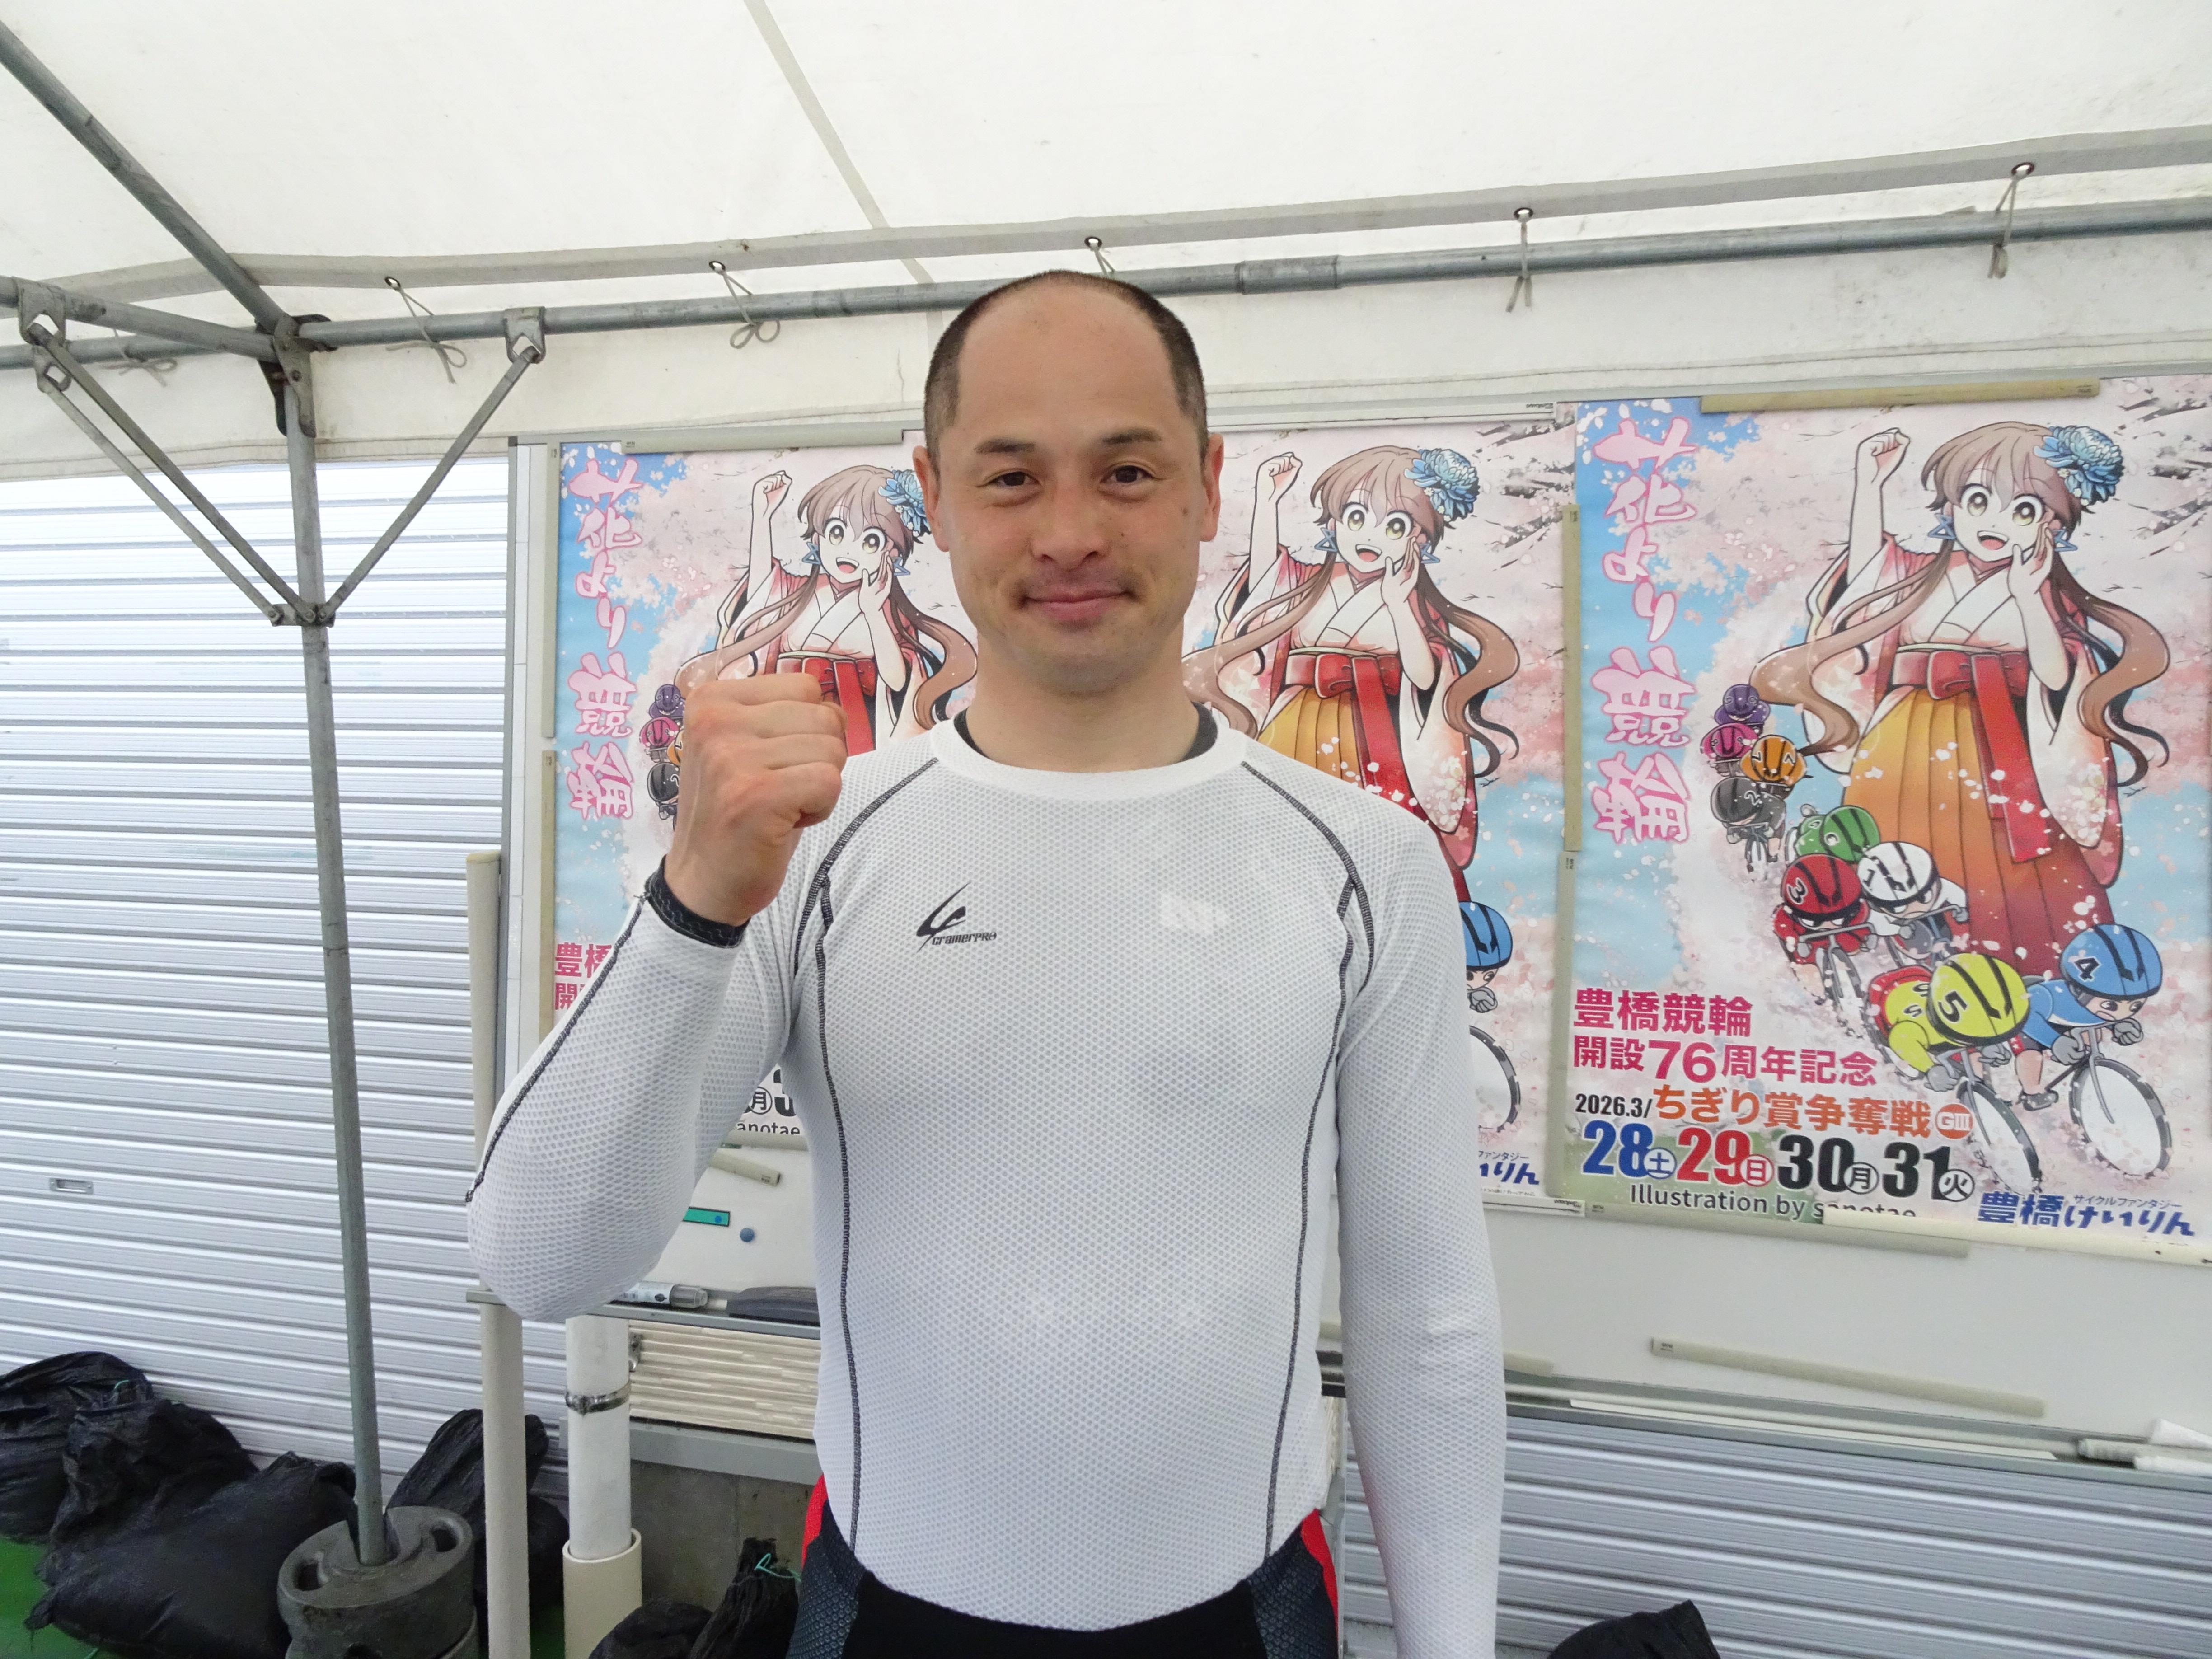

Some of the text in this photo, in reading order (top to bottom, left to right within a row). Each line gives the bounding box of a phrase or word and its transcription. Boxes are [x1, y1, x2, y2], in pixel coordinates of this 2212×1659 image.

[568, 457, 642, 820] 花より競輪
[1590, 417, 1697, 844] 花より競輪
[1786, 877, 1808, 904] 3
[1863, 868, 1876, 891] 1
[2074, 956, 2101, 981] 4
[555, 982, 585, 1010] 開
[1573, 988, 1753, 1037] 豊橋競輪
[1937, 990, 1968, 1023] 5
[1573, 1035, 1878, 1087] 開設76周年記念
[1575, 1093, 1654, 1119] 2026.3/
[1653, 1084, 1931, 1139] ちぎり賞争奪戦
[1630, 1184, 1767, 1214] Illustration
[1776, 1195, 1807, 1219] by
[1977, 1191, 2195, 1237] 豊橋けいりん
[2073, 1194, 2183, 1209] サイクルファンタジー
